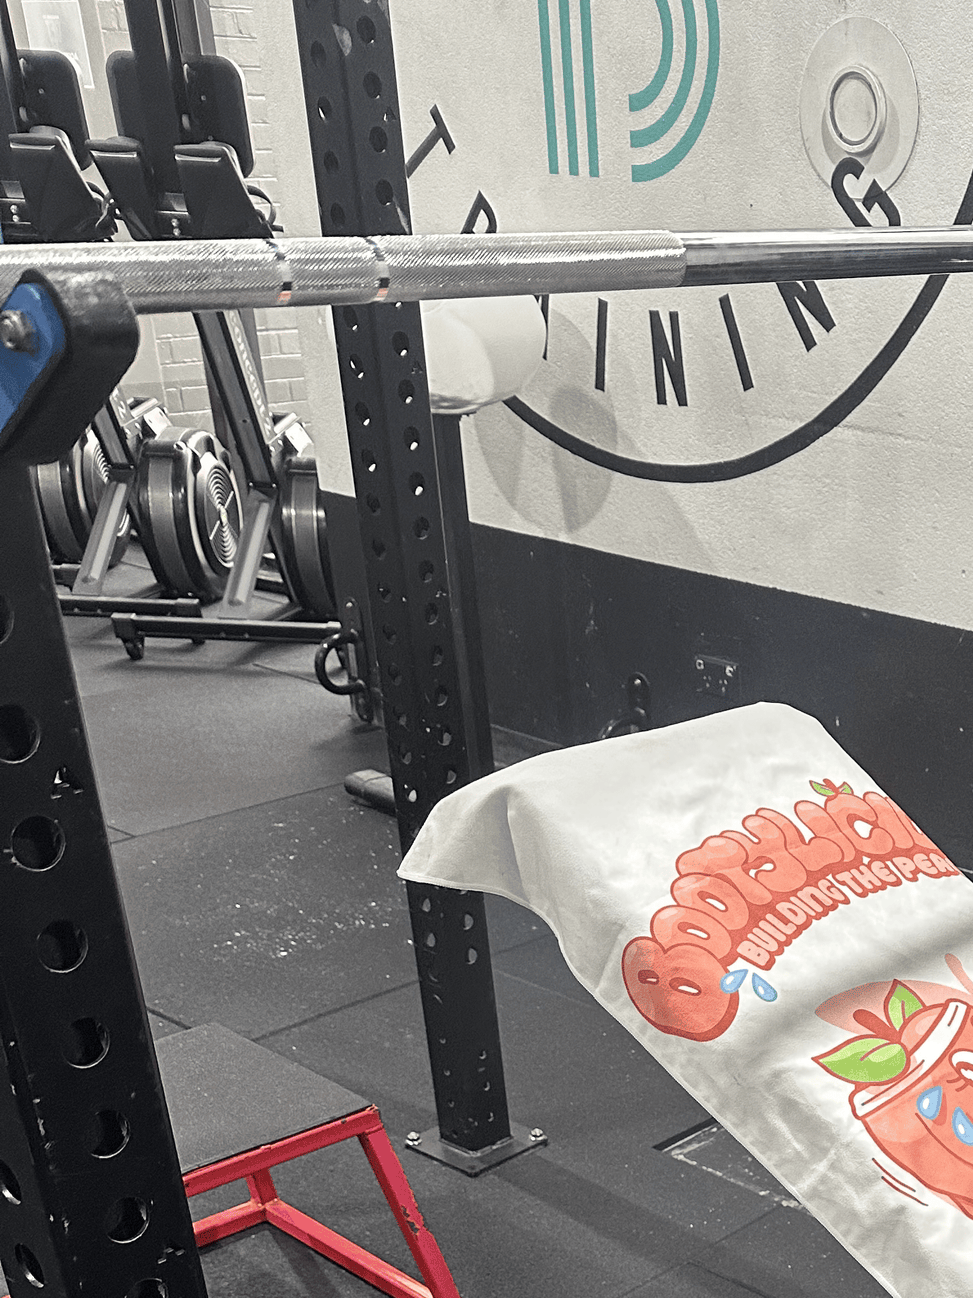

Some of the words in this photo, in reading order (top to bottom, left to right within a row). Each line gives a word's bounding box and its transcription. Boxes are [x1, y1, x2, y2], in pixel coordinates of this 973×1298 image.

[622, 791, 945, 1043] BOOTYLICI
[737, 877, 851, 970] BUILDING
[836, 857, 899, 899] THE
[896, 851, 962, 882] PEA
